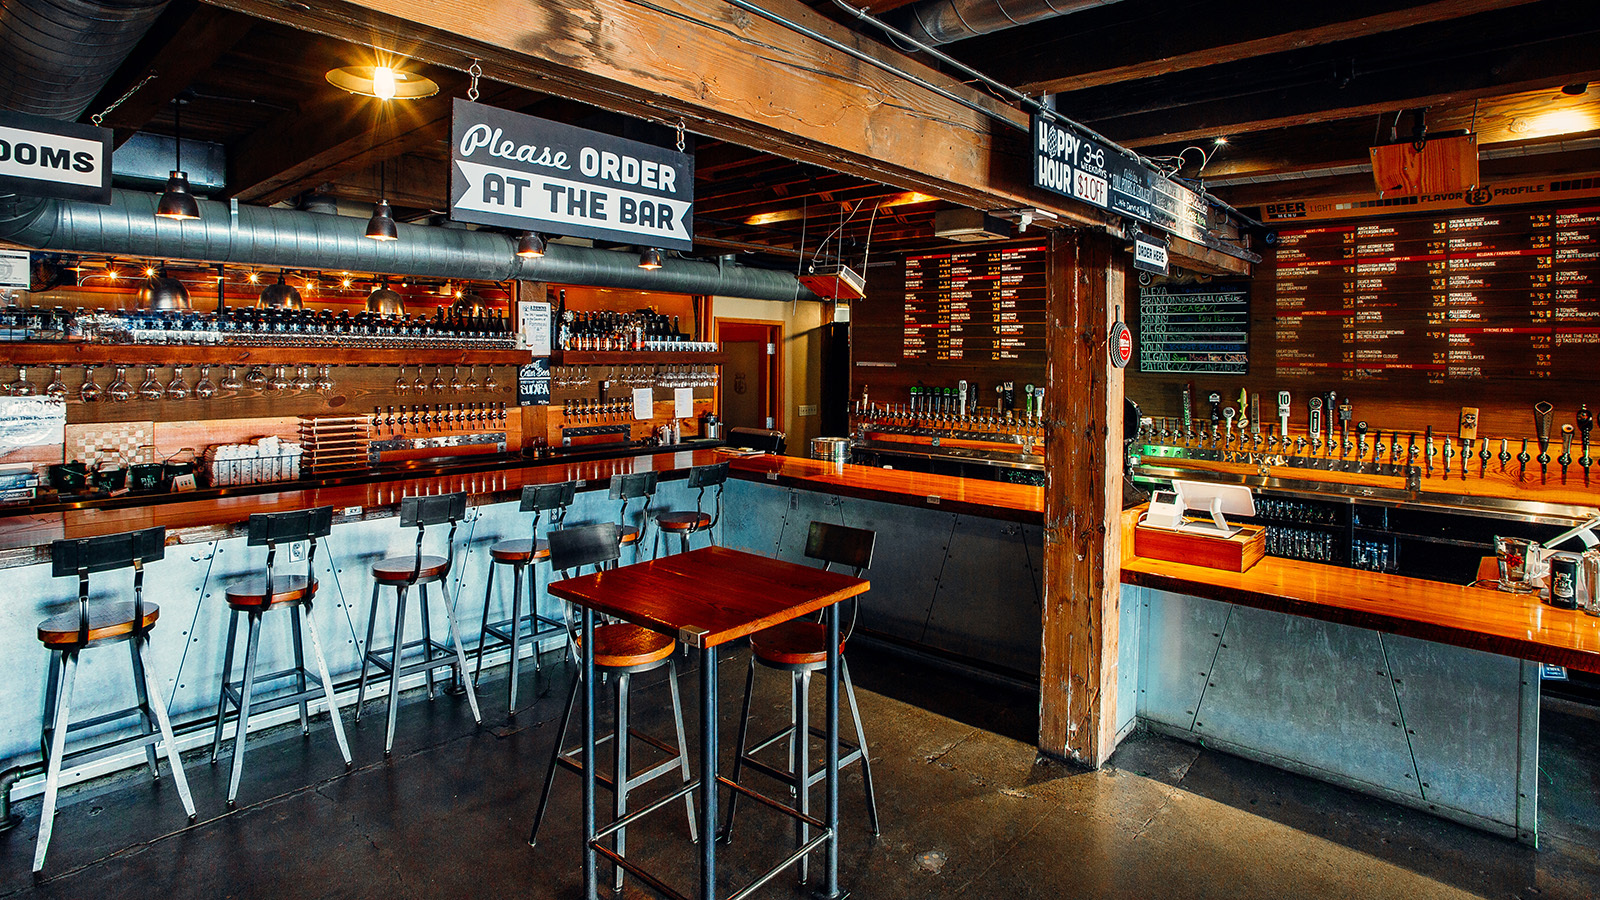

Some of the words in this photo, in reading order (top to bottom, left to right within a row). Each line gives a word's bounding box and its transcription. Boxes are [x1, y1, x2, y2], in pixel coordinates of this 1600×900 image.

[460, 124, 571, 170] Please
[580, 147, 677, 193] ORDER
[1039, 155, 1071, 194] HOUR
[483, 173, 530, 208] AT
[543, 182, 608, 221] THE
[620, 196, 674, 231] BAR
[1420, 192, 1462, 202] FLAVOR
[1495, 185, 1544, 196] PROFILE
[1266, 202, 1306, 214] BEER
[1310, 204, 1332, 212] LIGHT
[1138, 244, 1152, 258] ORDER
[1154, 249, 1164, 262] HERE
[1141, 287, 1167, 295] ALEXA
[1141, 325, 1166, 333] DIEGO
[1280, 395, 1289, 405] 10
